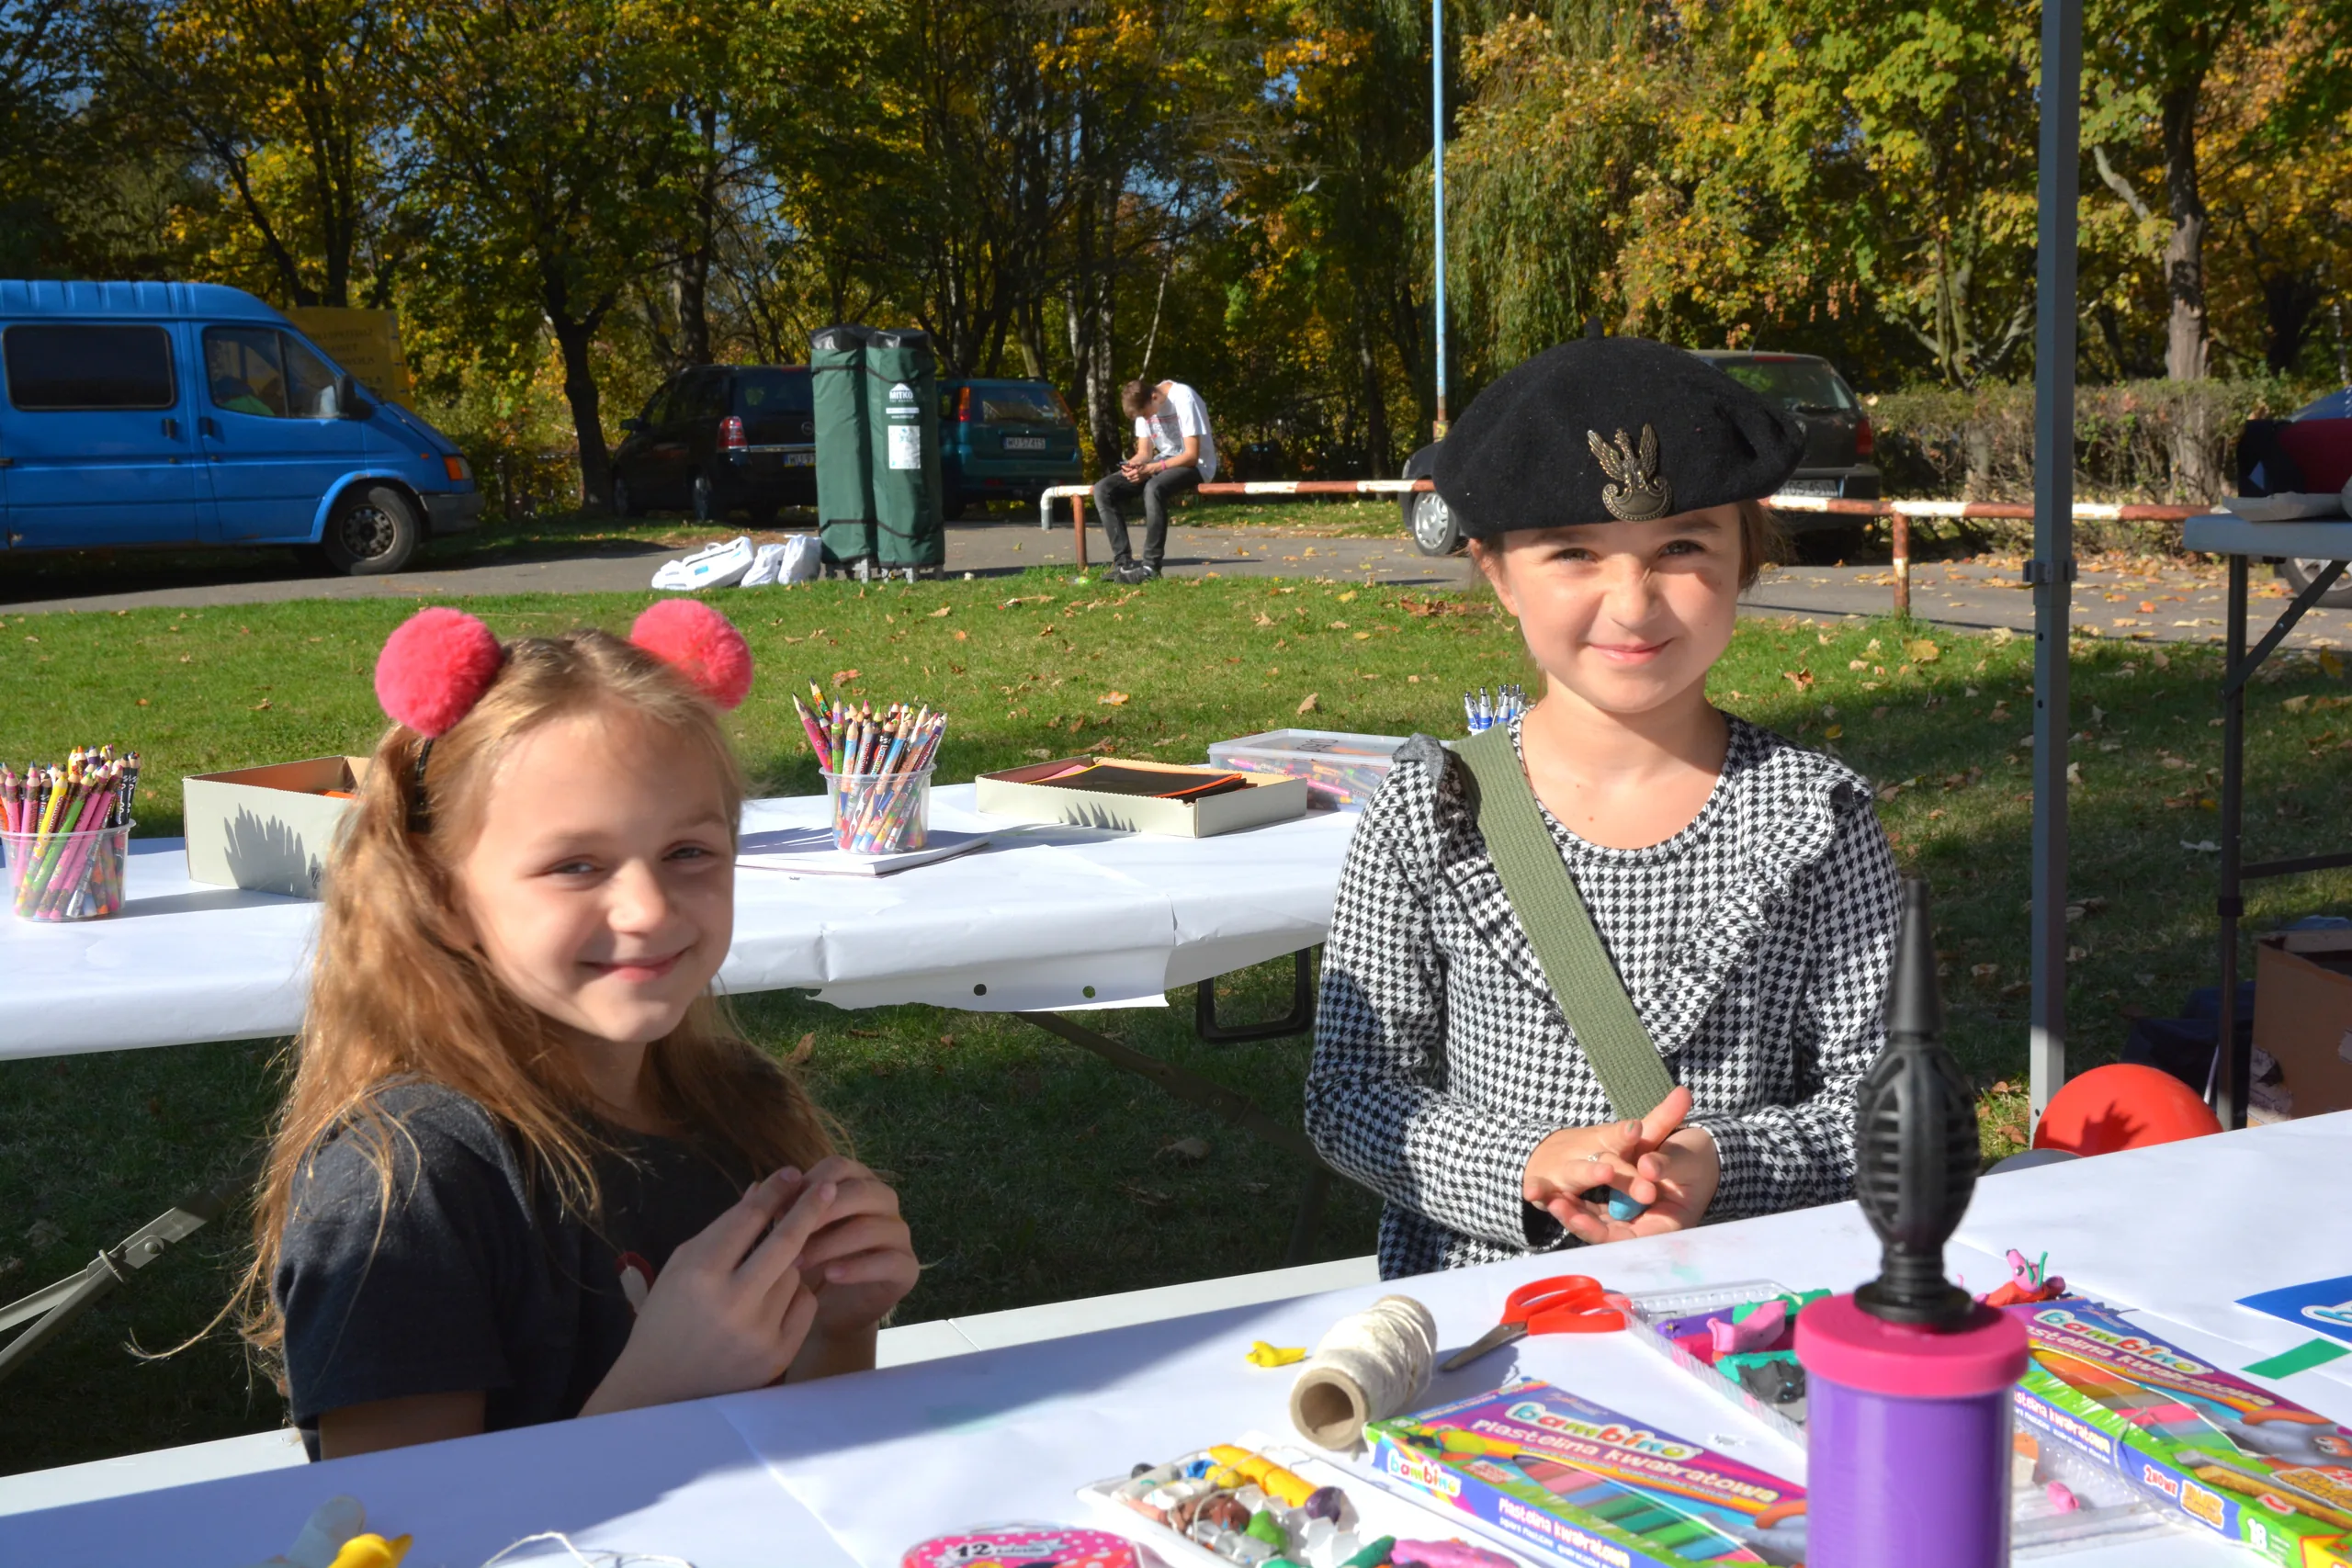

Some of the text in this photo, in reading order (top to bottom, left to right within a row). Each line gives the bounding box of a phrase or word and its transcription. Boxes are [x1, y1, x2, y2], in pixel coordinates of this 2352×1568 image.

[888, 390, 913, 400] MITKO
[2025, 1325, 2113, 1358] astelina
[2034, 1310, 2203, 1373] bambino
[1471, 1419, 1600, 1456] Plastelina
[1509, 1403, 1695, 1460] bambino
[1388, 1450, 1460, 1495] bambino
[956, 1543, 991, 1557] 12
